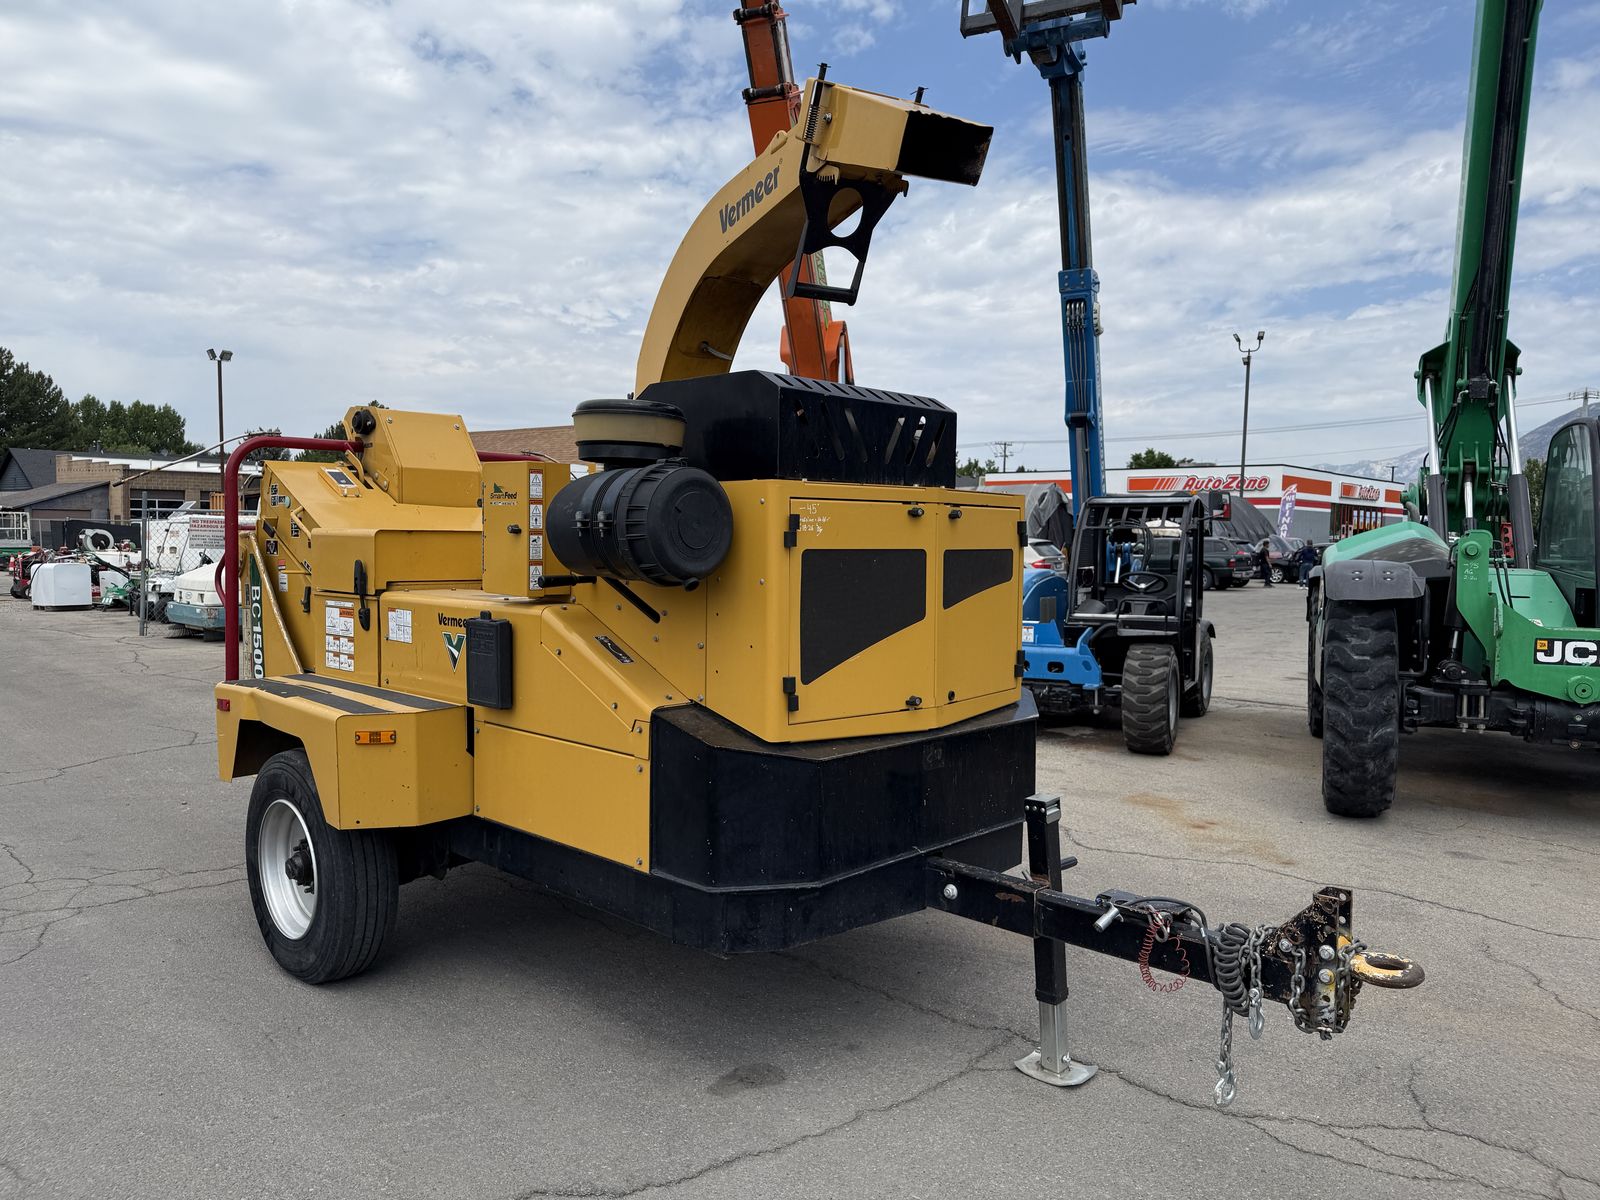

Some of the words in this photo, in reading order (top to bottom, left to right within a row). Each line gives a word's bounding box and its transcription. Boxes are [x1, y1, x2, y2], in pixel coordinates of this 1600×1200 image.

[719, 165, 780, 234] Vermeer
[1182, 476, 1268, 490] AutoZone
[1280, 502, 1292, 538] FINAN
[251, 585, 264, 679] BC1500
[438, 612, 467, 628] Vermee
[1536, 640, 1600, 665] JC
